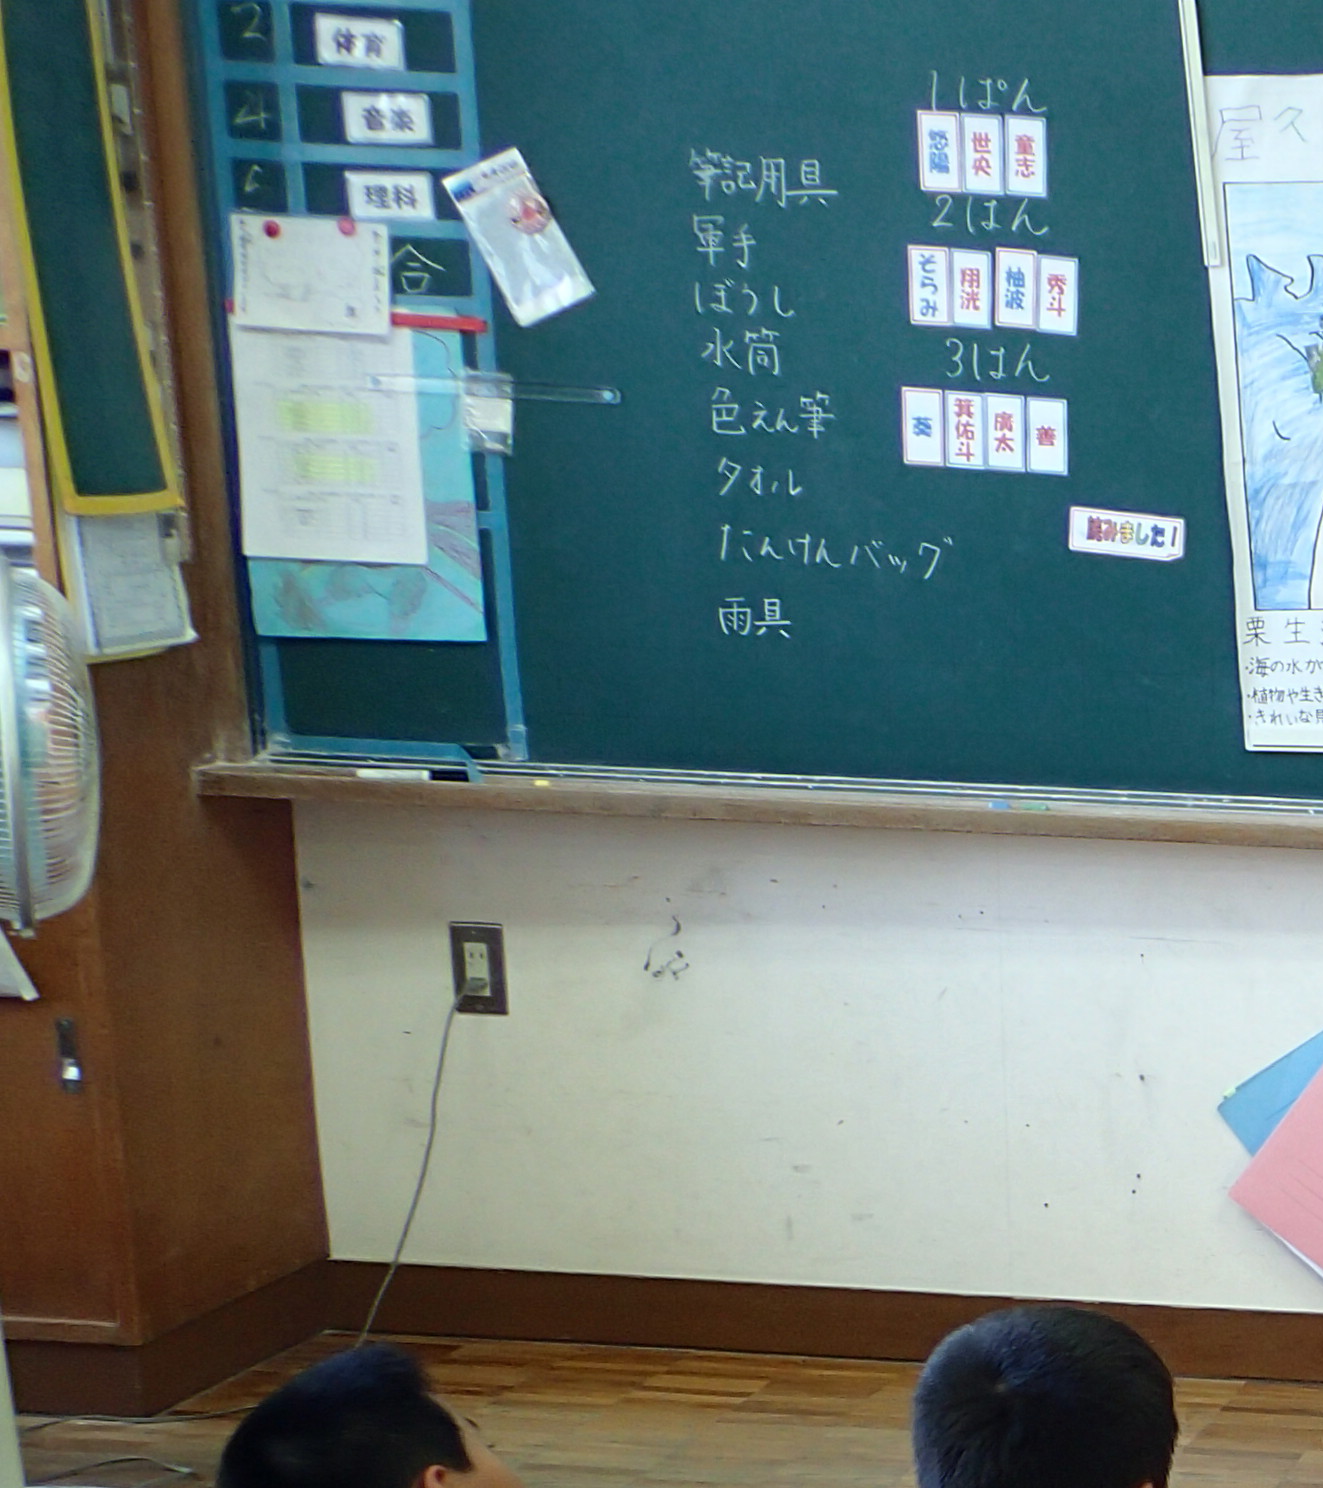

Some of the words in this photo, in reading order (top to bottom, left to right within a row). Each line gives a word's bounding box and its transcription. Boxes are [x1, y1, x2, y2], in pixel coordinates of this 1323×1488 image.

[364, 184, 419, 210] 理科
[689, 148, 838, 208] 筆記用具
[693, 213, 757, 269] 軍手
[695, 277, 796, 318] ぼうし
[701, 327, 781, 377] 水筒
[711, 386, 836, 439] 色えん筆
[718, 457, 803, 496] タオル
[720, 522, 954, 580] たんけんバッグ
[718, 597, 792, 638] 雨具
